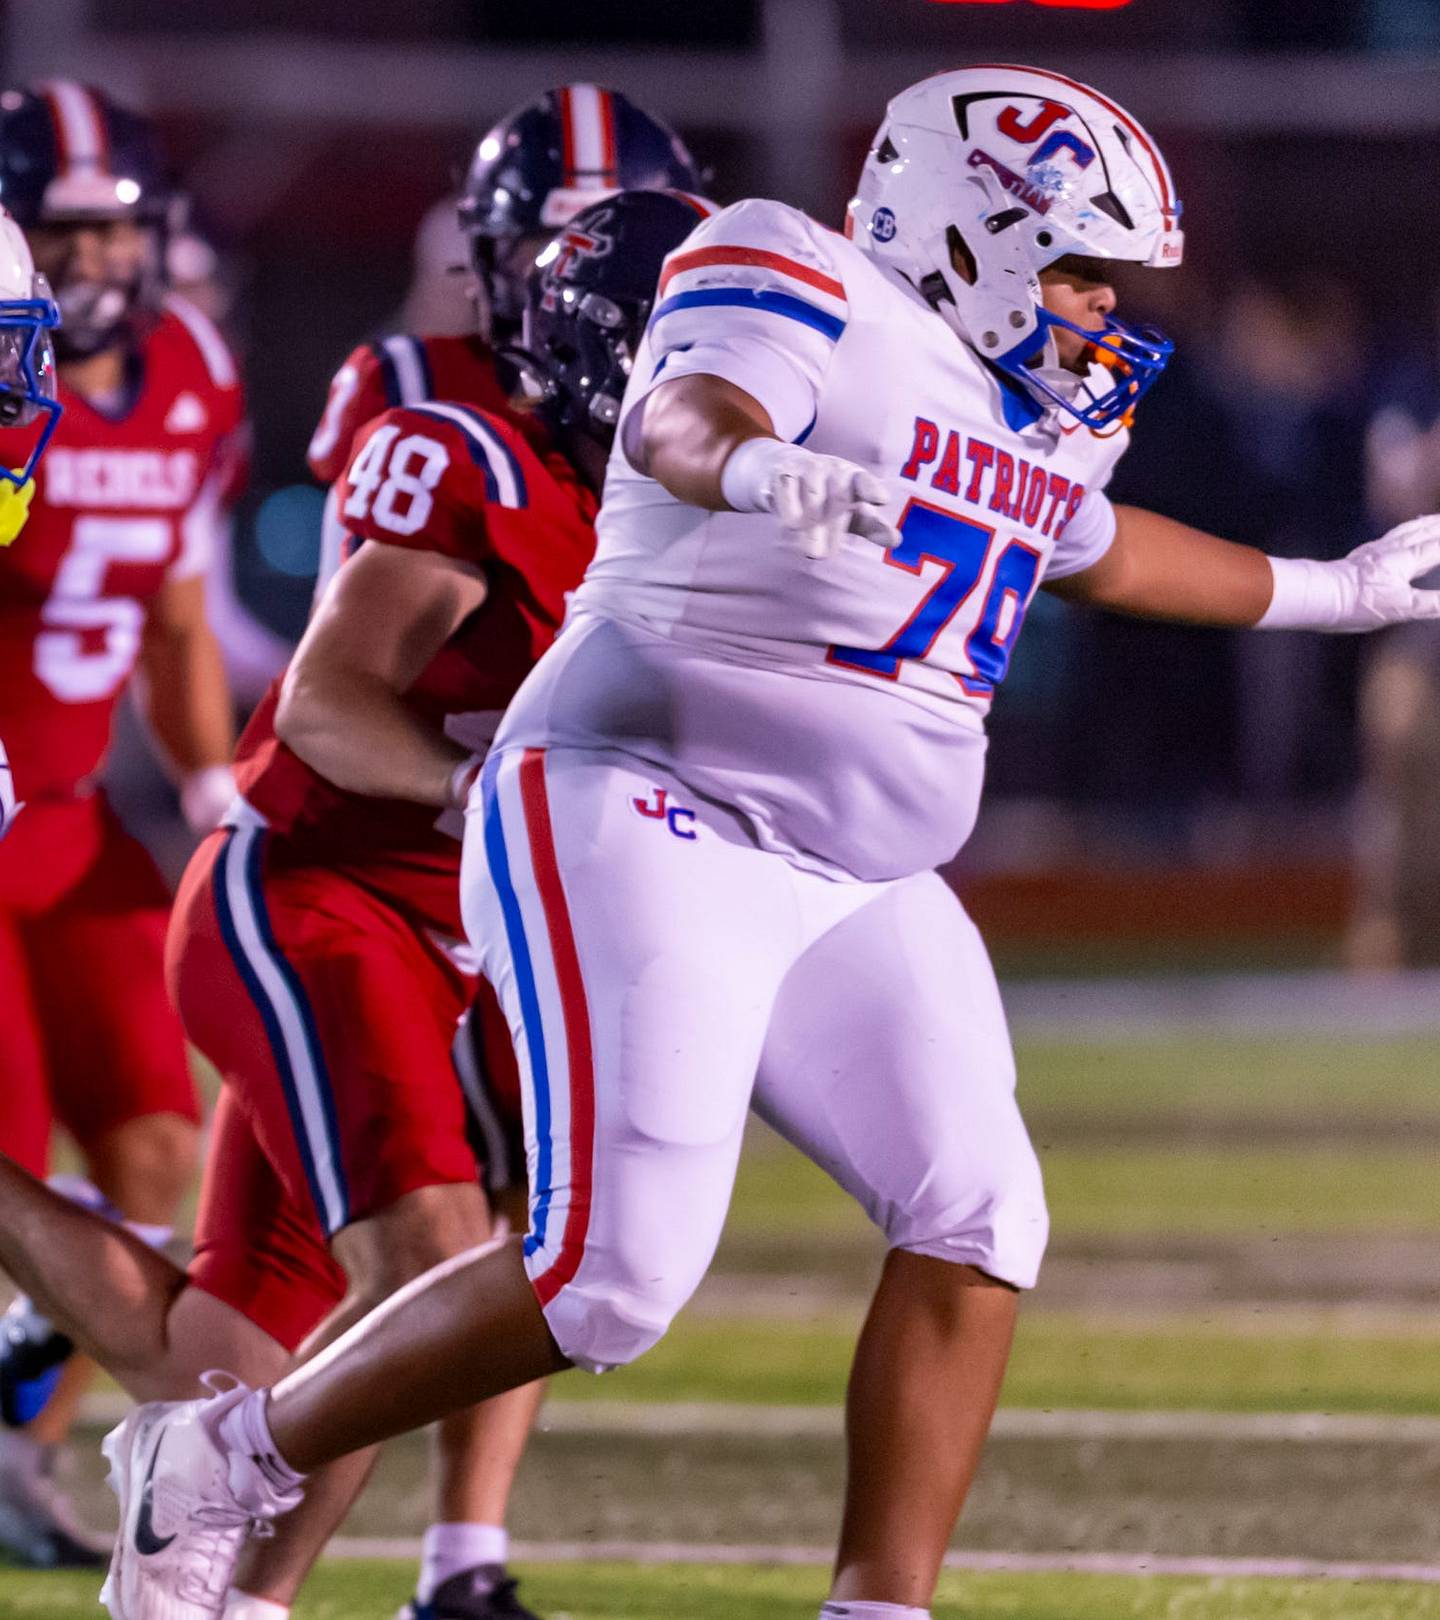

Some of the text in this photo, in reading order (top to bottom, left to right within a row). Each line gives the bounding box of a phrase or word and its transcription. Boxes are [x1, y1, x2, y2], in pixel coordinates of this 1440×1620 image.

[343, 424, 451, 536] 48
[900, 416, 1086, 541] PATRIOTS
[33, 513, 173, 703] 5
[633, 788, 697, 840] JC
